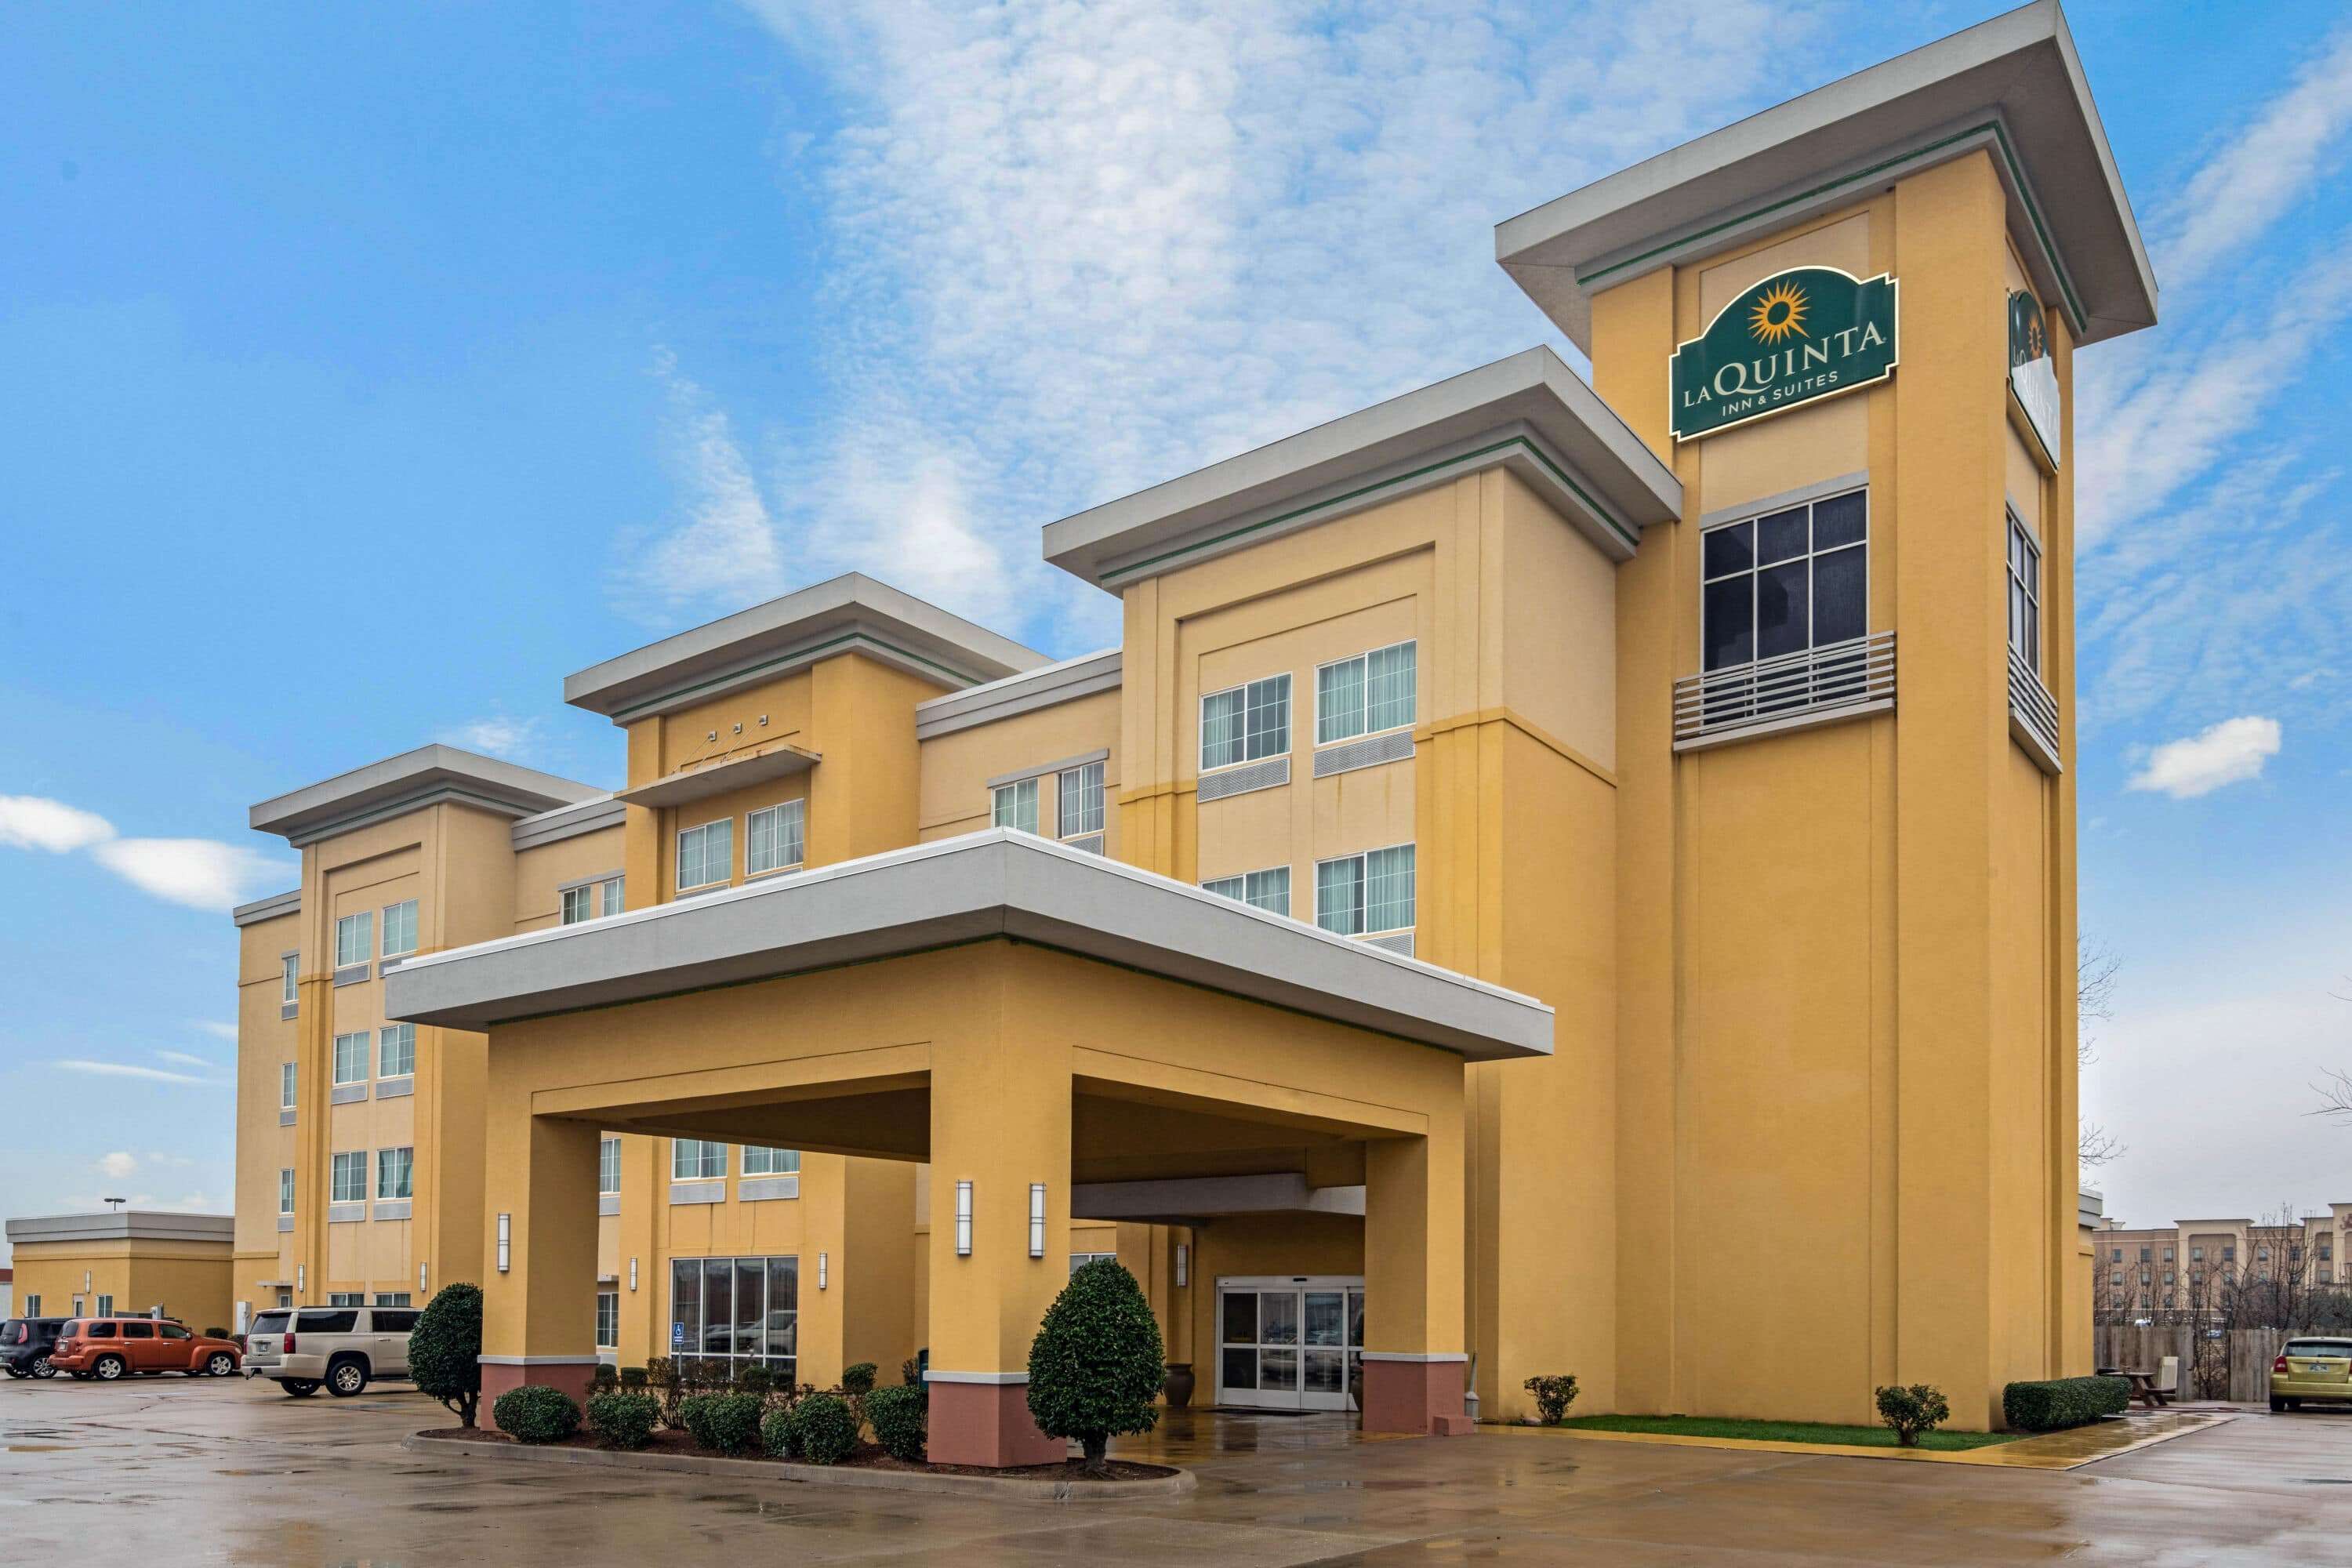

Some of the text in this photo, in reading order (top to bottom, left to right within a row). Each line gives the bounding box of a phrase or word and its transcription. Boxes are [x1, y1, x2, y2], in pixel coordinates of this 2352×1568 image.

[1684, 321, 1884, 408] LA QUINTA
[1722, 371, 1838, 416] INN & SUITES
